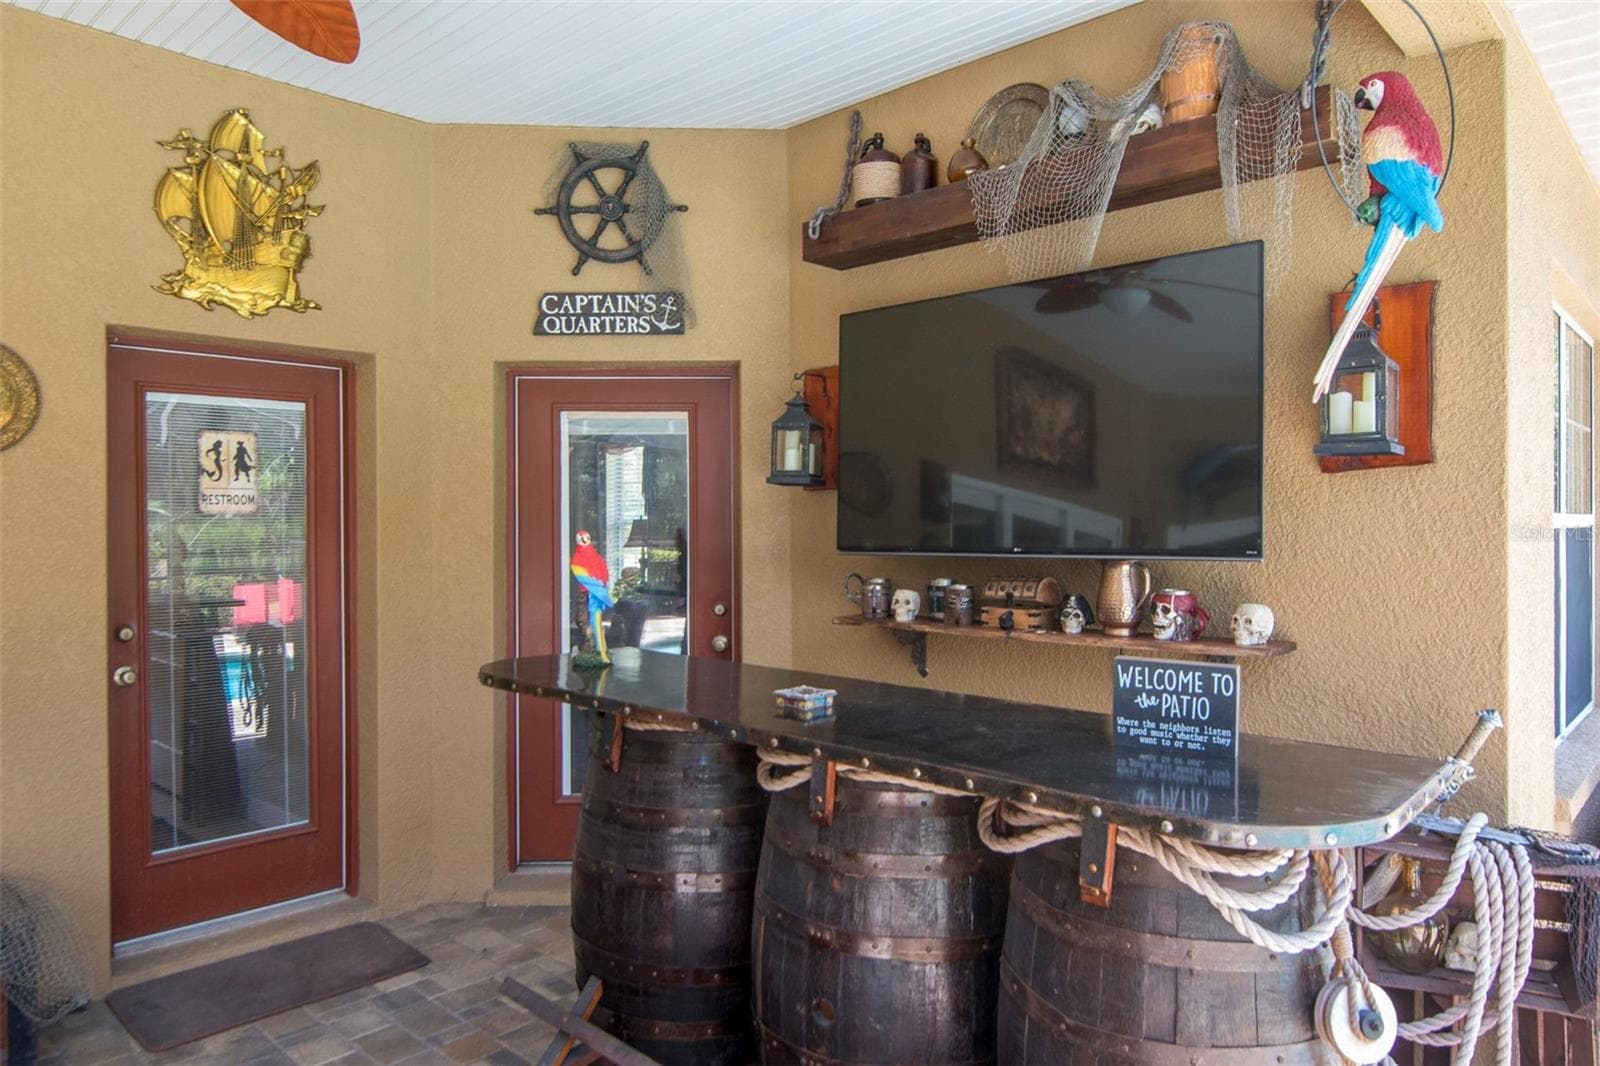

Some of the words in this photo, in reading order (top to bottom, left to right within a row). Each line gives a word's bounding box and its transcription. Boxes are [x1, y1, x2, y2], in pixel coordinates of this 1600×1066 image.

[541, 294, 657, 313] CAPTAIN'S
[543, 315, 650, 334] QUARTERS
[201, 494, 255, 505] RESTROOM
[1117, 664, 1203, 693] WELCOME
[1211, 672, 1234, 696] TO
[1134, 692, 1160, 708] the
[1161, 693, 1210, 720] PATIO
[1116, 716, 1139, 727] Where
[1143, 719, 1156, 729] the
[1159, 722, 1200, 733] neighbors
[1204, 726, 1231, 737] listen
[1117, 725, 1127, 733] to
[1129, 727, 1147, 736] good
[1150, 729, 1173, 739] music
[1176, 731, 1209, 743] whether
[1212, 735, 1231, 746] they
[1139, 736, 1157, 745] want
[1161, 737, 1171, 746] to
[1174, 740, 1184, 748] or
[1187, 741, 1205, 750] not.
